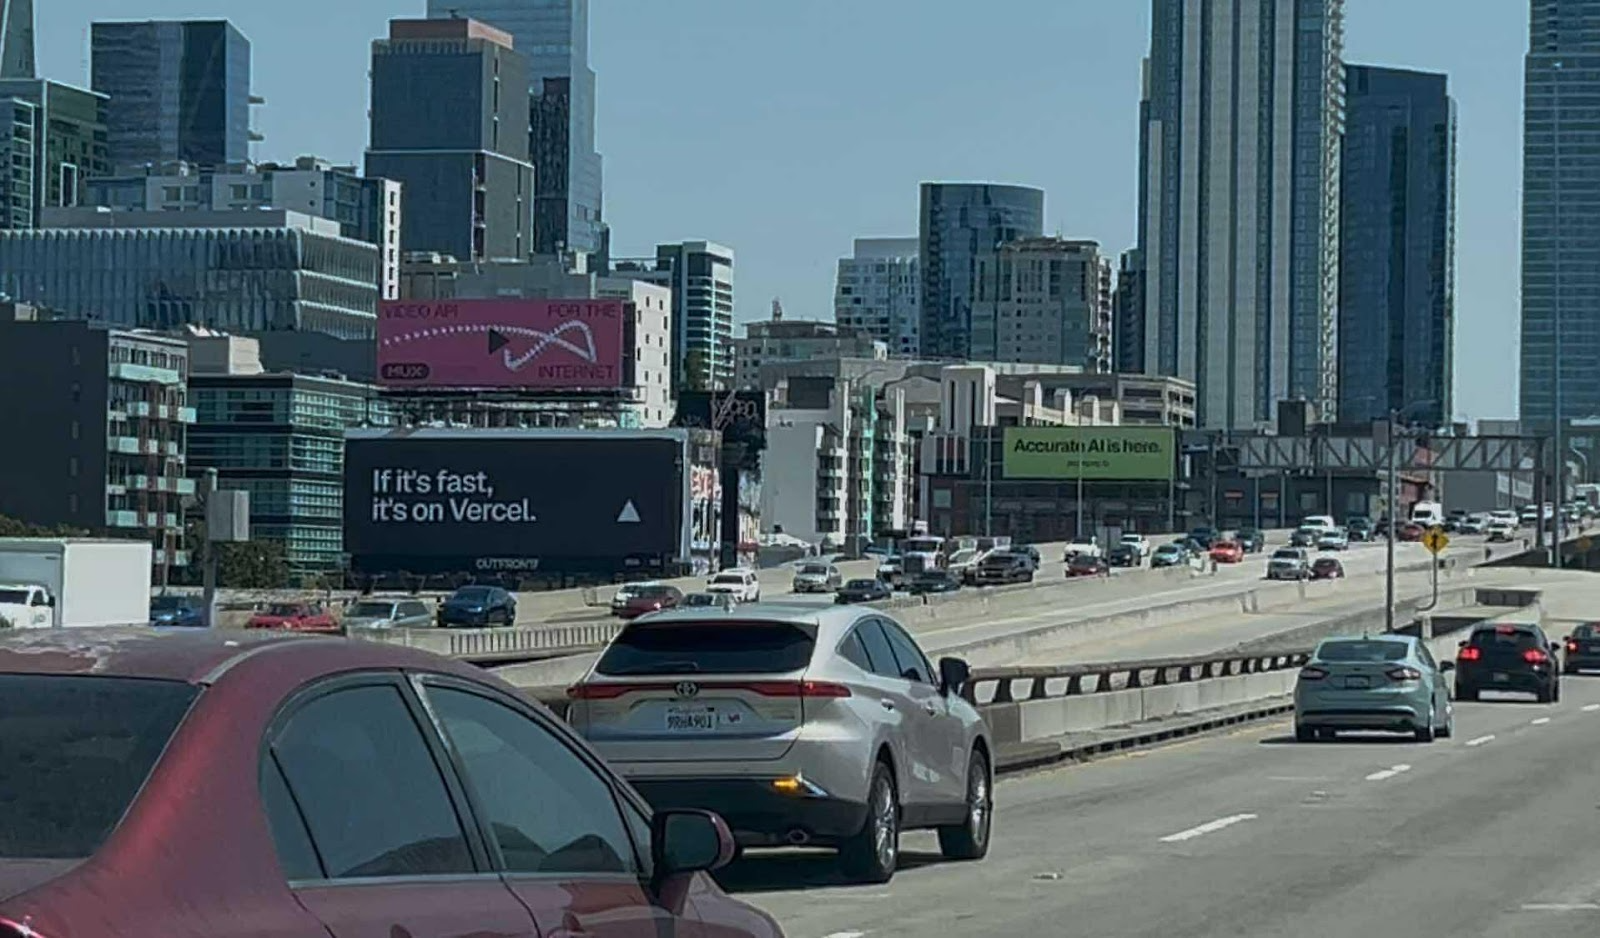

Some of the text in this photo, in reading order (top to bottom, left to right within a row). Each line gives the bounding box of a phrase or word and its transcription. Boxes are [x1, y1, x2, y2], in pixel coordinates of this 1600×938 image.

[383, 304, 459, 318] VIDEO API
[547, 304, 616, 318] FOR THE
[386, 366, 423, 377] MUX
[538, 365, 614, 379] INTERNET
[1014, 438, 1162, 453] Accurate AI is here.
[373, 469, 494, 498] If it's fast,
[372, 497, 537, 521] it's on Vercel.
